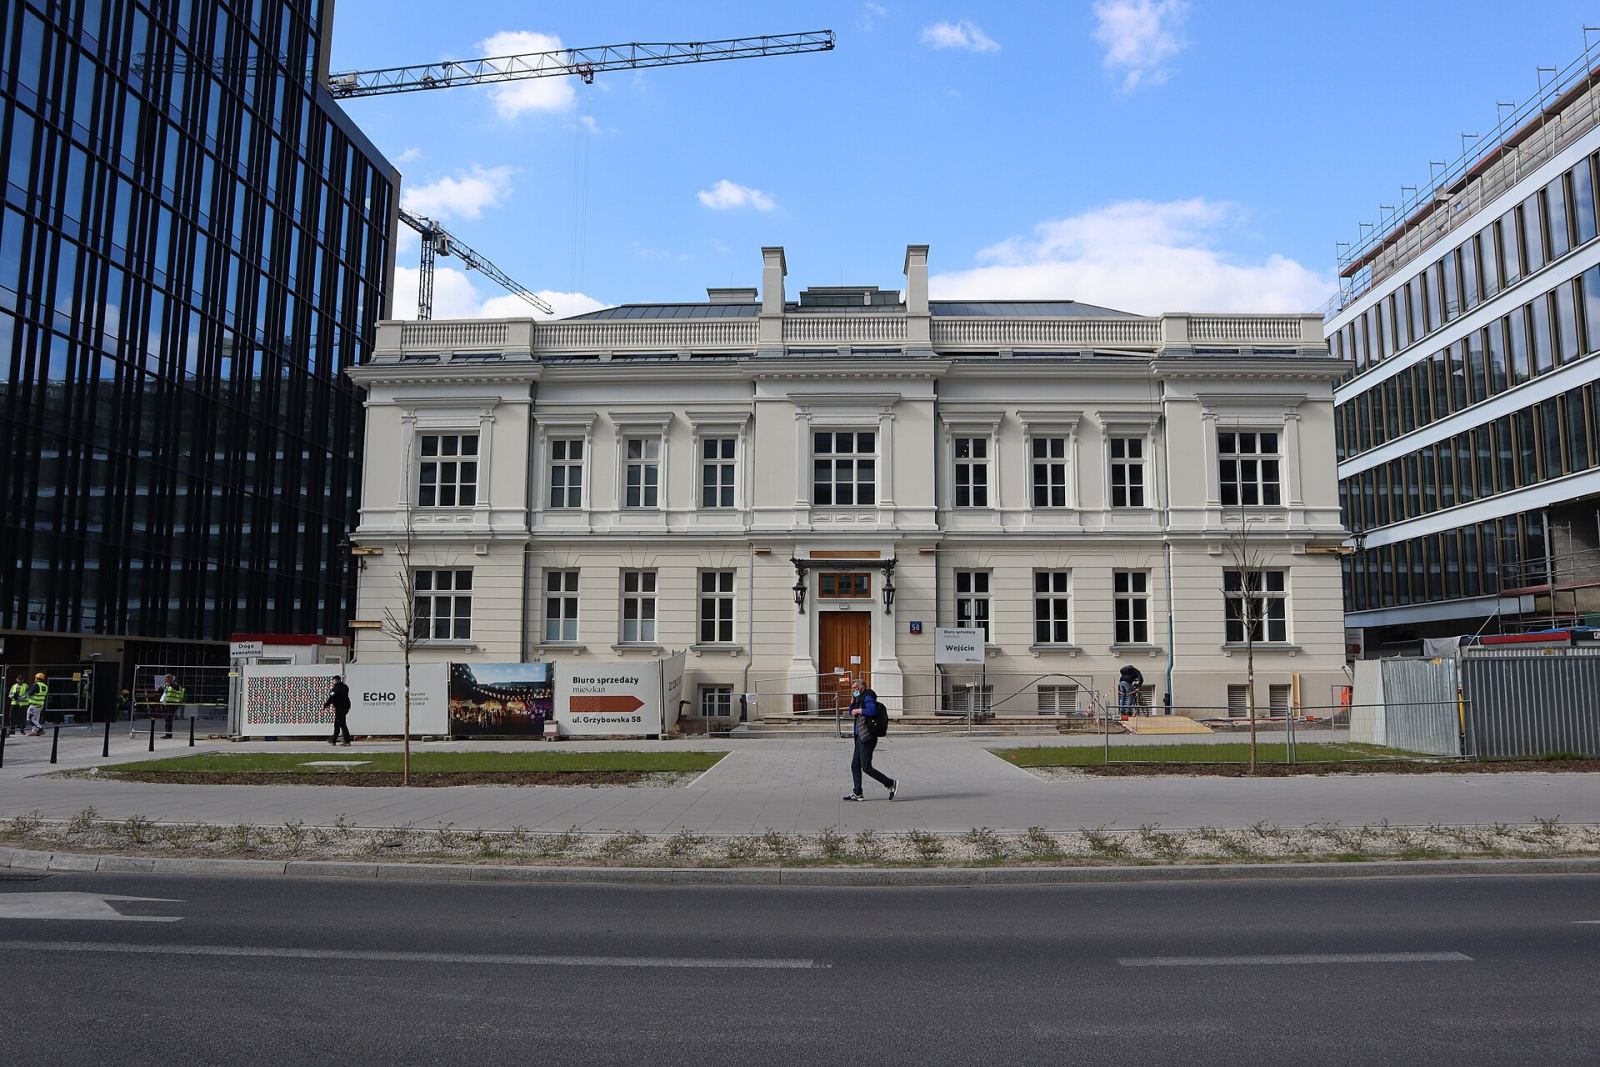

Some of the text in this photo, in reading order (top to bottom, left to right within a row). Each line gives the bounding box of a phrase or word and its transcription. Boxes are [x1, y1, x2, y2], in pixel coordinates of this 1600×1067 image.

[945, 644, 975, 652] Wejście
[572, 676, 640, 685] Biuro sprzedaży
[363, 692, 396, 701] ECHO
[583, 716, 630, 725] Grzybowska
